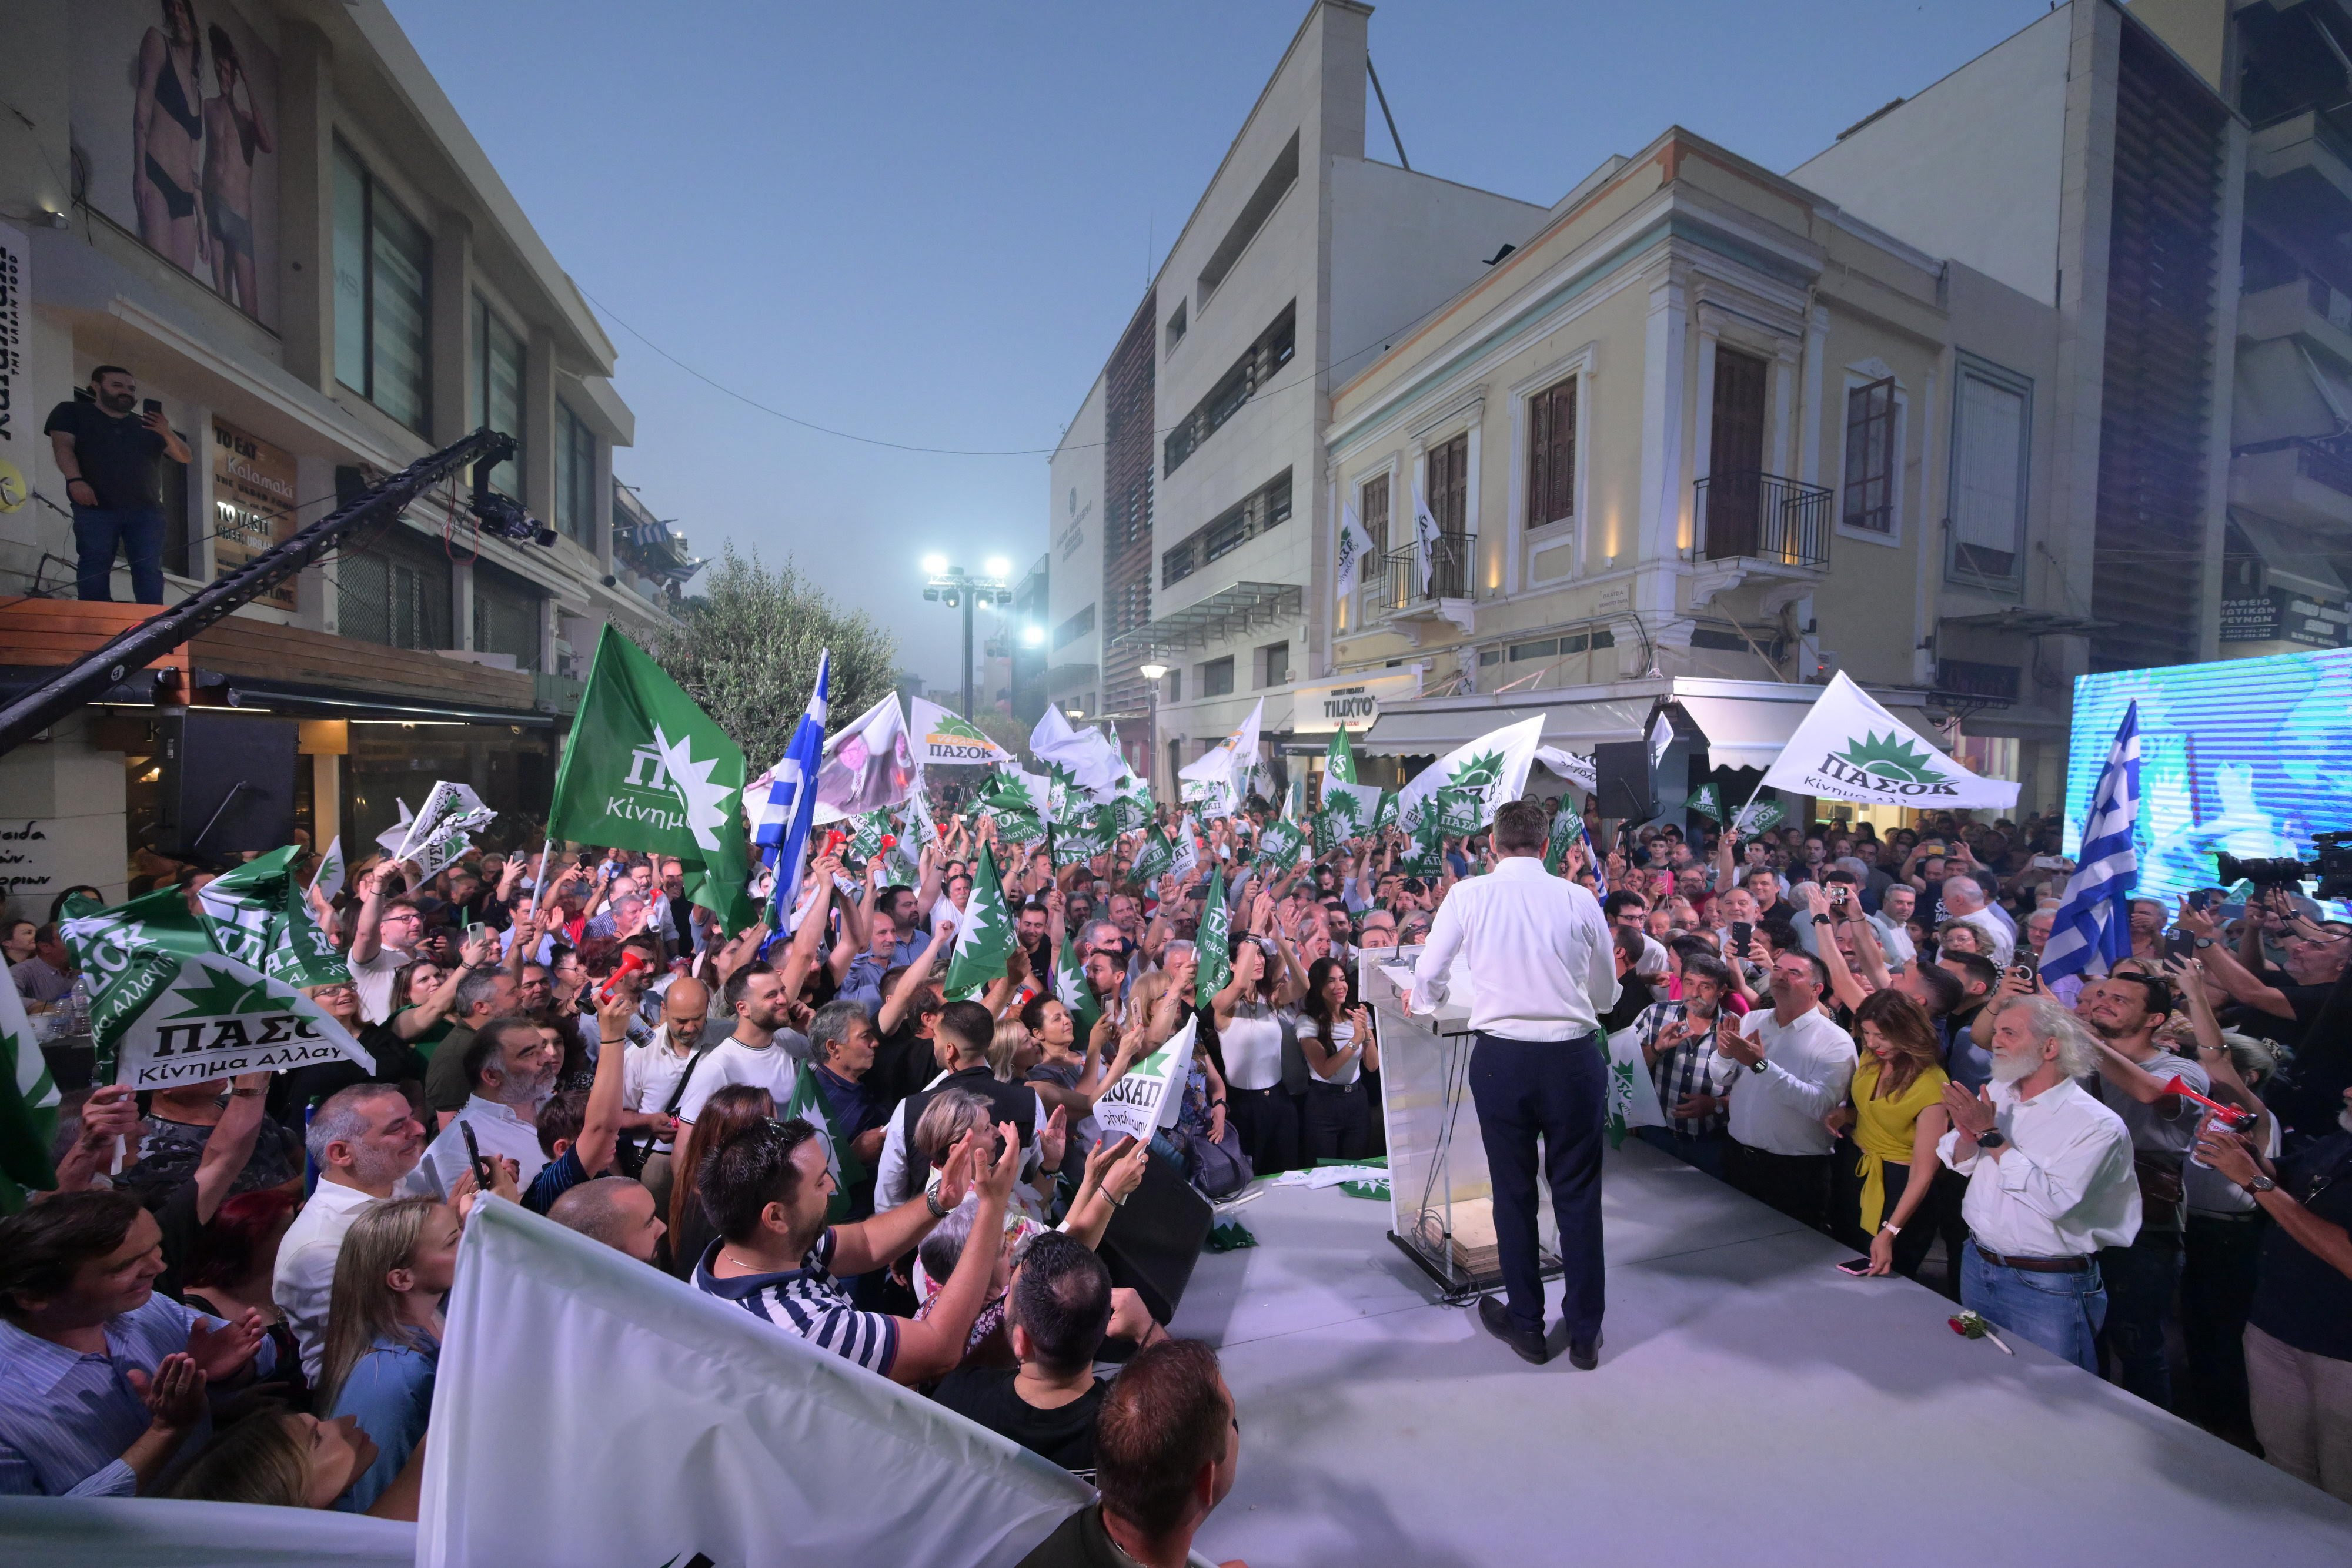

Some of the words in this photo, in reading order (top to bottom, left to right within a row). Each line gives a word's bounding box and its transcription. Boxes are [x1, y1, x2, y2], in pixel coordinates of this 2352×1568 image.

[215, 427, 233, 449] TO
[235, 437, 258, 460] EAT
[227, 455, 293, 499] Kalamaki
[216, 501, 235, 523] TO
[2221, 598, 2271, 607] ΡΑΦΕΙΟ
[2221, 606, 2276, 616] ΙΩΤΙΚΩΝ
[2220, 615, 2272, 624] ΡΕΥΝΩΝ
[930, 744, 993, 759] ΠΑΣΟΚ
[1817, 753, 1960, 796] ΠΑΣΟΚ
[1754, 805, 1779, 827] ΣΟΚ
[859, 827, 881, 851] ΠΑΣ
[153, 1015, 320, 1058] ΠΑΣΟ
[138, 1058, 248, 1084] Κίνημα
[256, 1047, 341, 1067] Αλλαγ
[2210, 1122, 2230, 1134] όρνα
